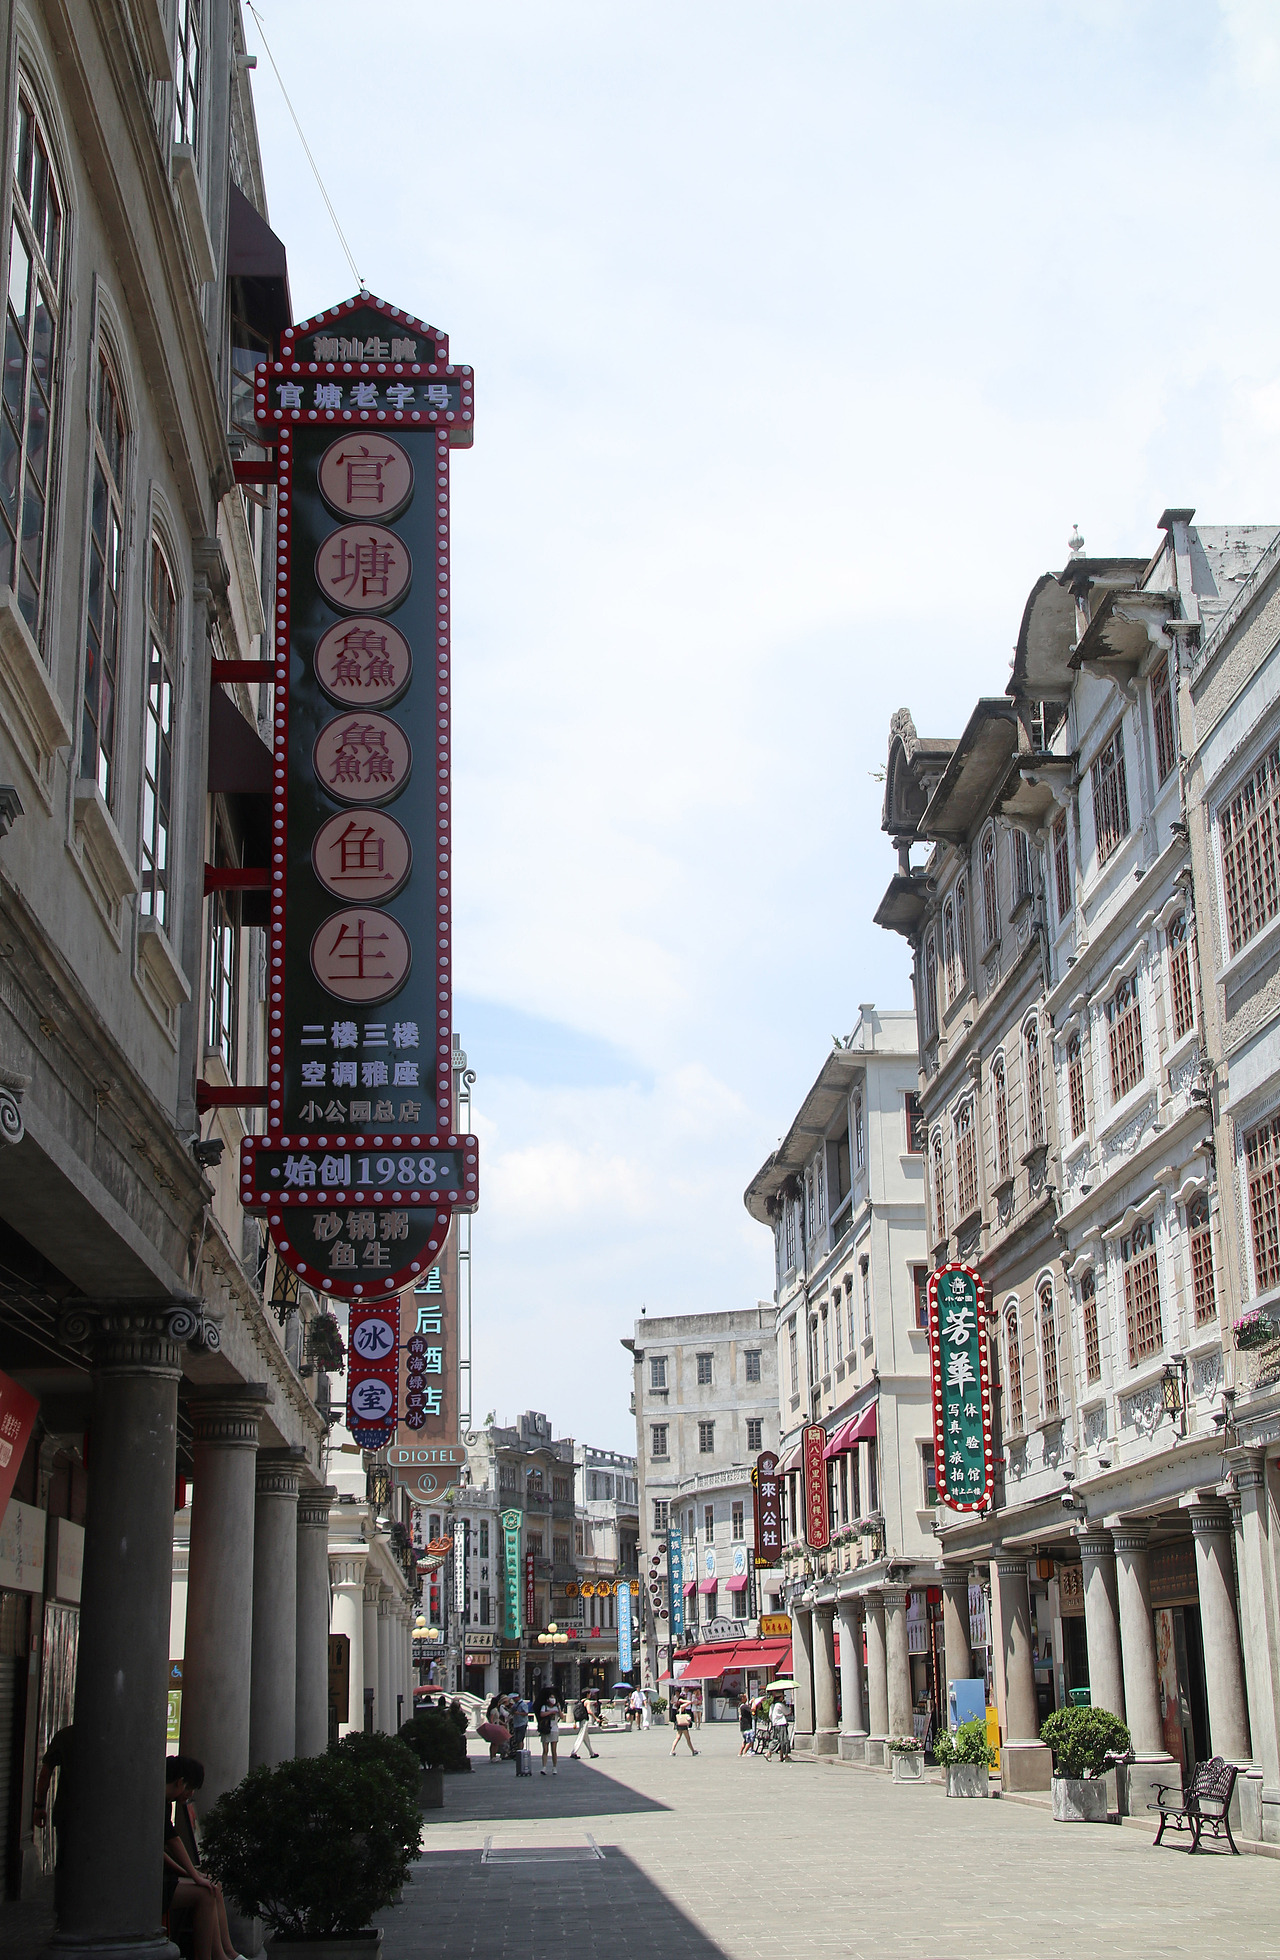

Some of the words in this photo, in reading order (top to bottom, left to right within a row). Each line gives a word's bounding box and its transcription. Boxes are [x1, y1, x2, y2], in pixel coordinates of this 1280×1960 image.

[275, 381, 452, 410] 官塘老字号
[300, 1021, 420, 1049] 二楼三楼
[301, 1061, 420, 1088] 空调雅座
[299, 1099, 421, 1123] 小公园总店
[313, 1211, 409, 1241] 砂锅粥
[328, 1240, 392, 1269] 鱼生
[358, 1325, 390, 1412] 冰室
[398, 1450, 457, 1462] DIOTEL
[963, 1402, 981, 1482] 体验馆
